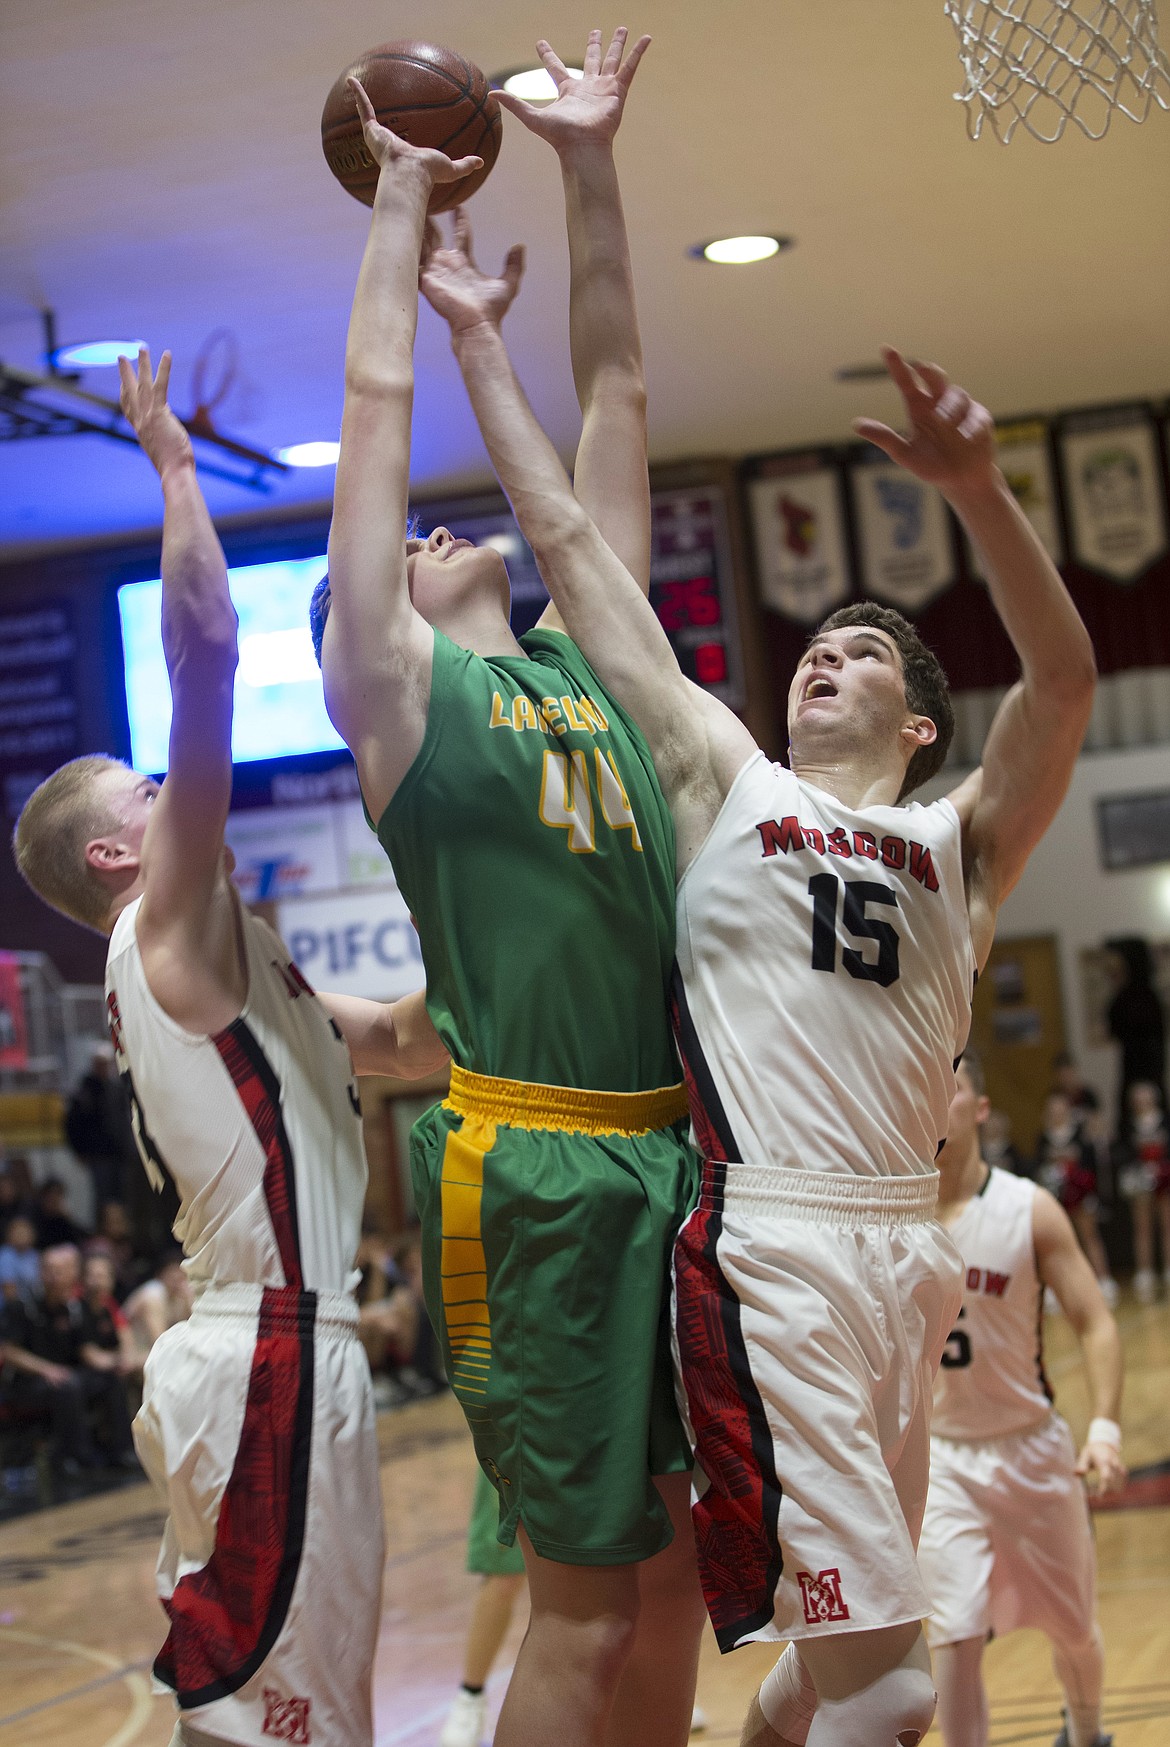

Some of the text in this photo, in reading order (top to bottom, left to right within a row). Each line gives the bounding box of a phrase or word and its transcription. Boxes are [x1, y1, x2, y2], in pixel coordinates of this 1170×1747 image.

[538, 747, 643, 854] 44
[756, 816, 940, 893] MOSCOW
[808, 873, 900, 988] 15
[796, 1568, 850, 1624] M
